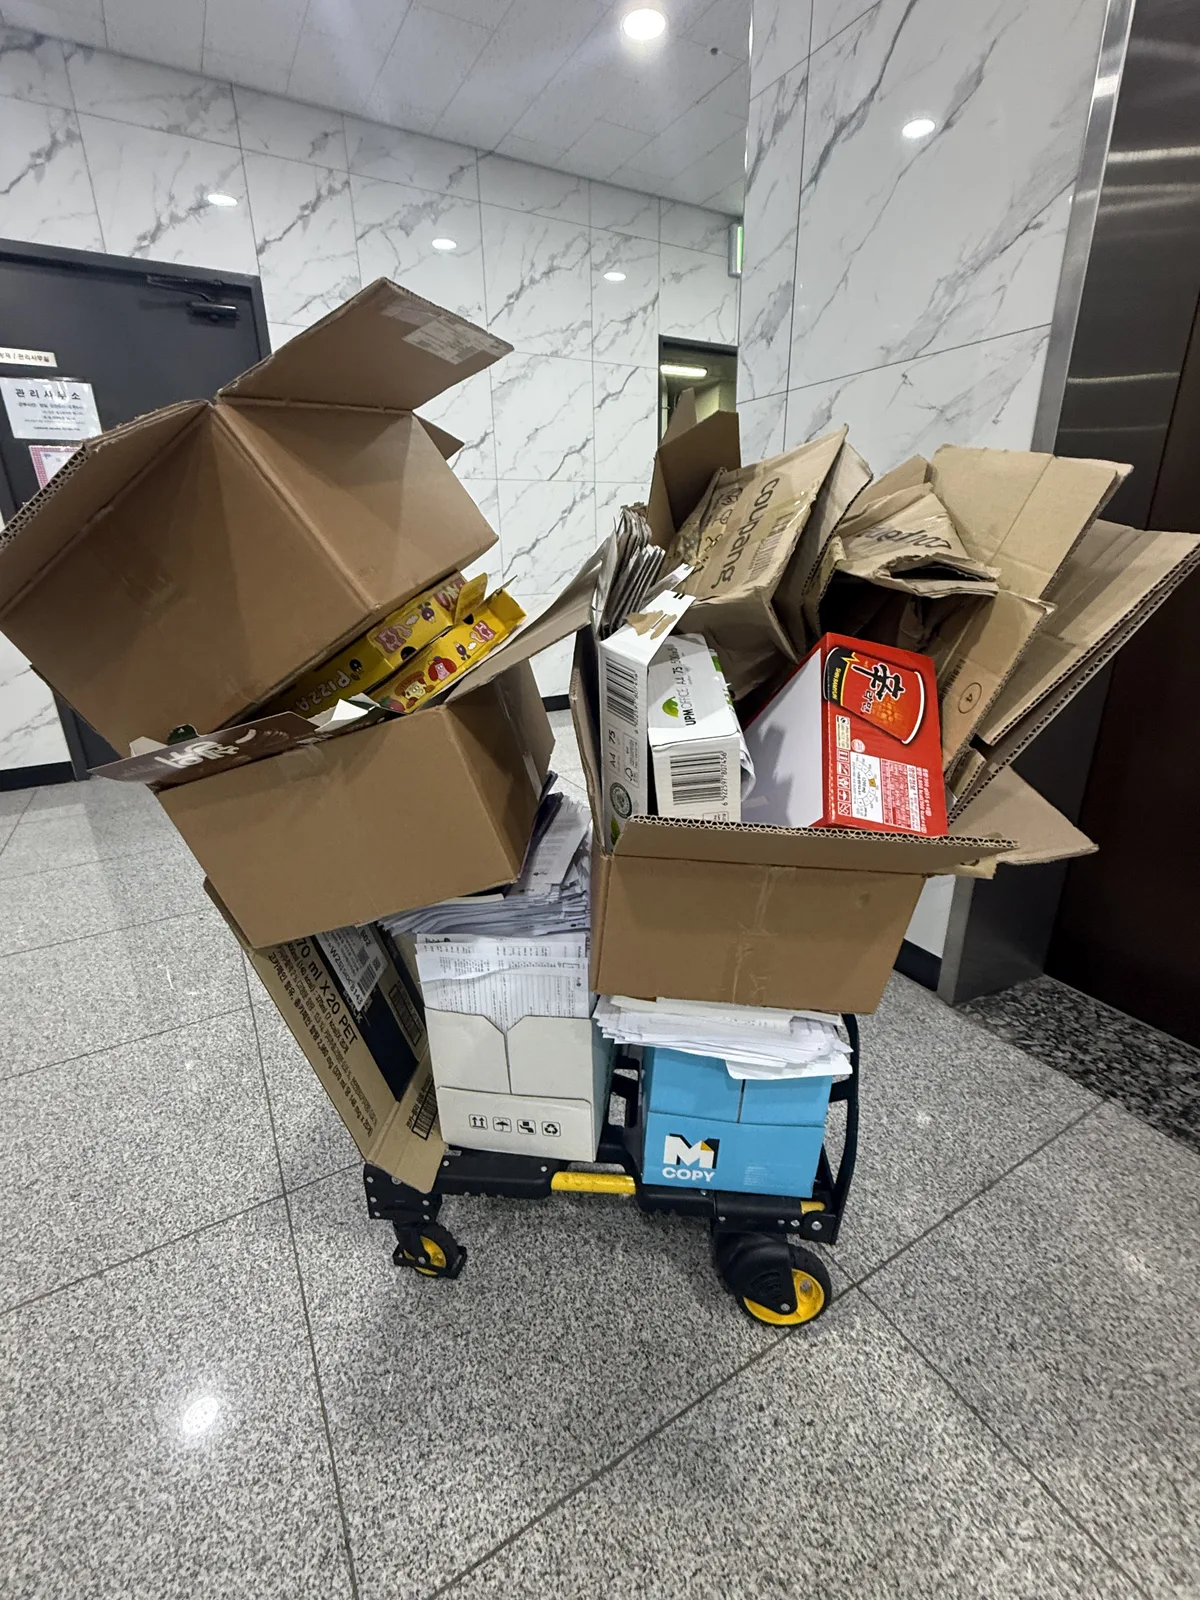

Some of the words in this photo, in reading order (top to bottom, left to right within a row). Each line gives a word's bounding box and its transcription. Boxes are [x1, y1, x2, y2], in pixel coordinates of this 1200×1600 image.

[711, 477, 780, 590] coupang
[672, 666, 684, 676] 75
[850, 661, 906, 701] 辛
[296, 671, 350, 711] PIZZA
[860, 689, 875, 714] 라면
[683, 708, 697, 726] UPM
[608, 729, 616, 745] 75
[608, 752, 617, 768] A4
[308, 961, 323, 980] ml
[338, 1016, 358, 1044] PET
[662, 1167, 715, 1182] COPY
